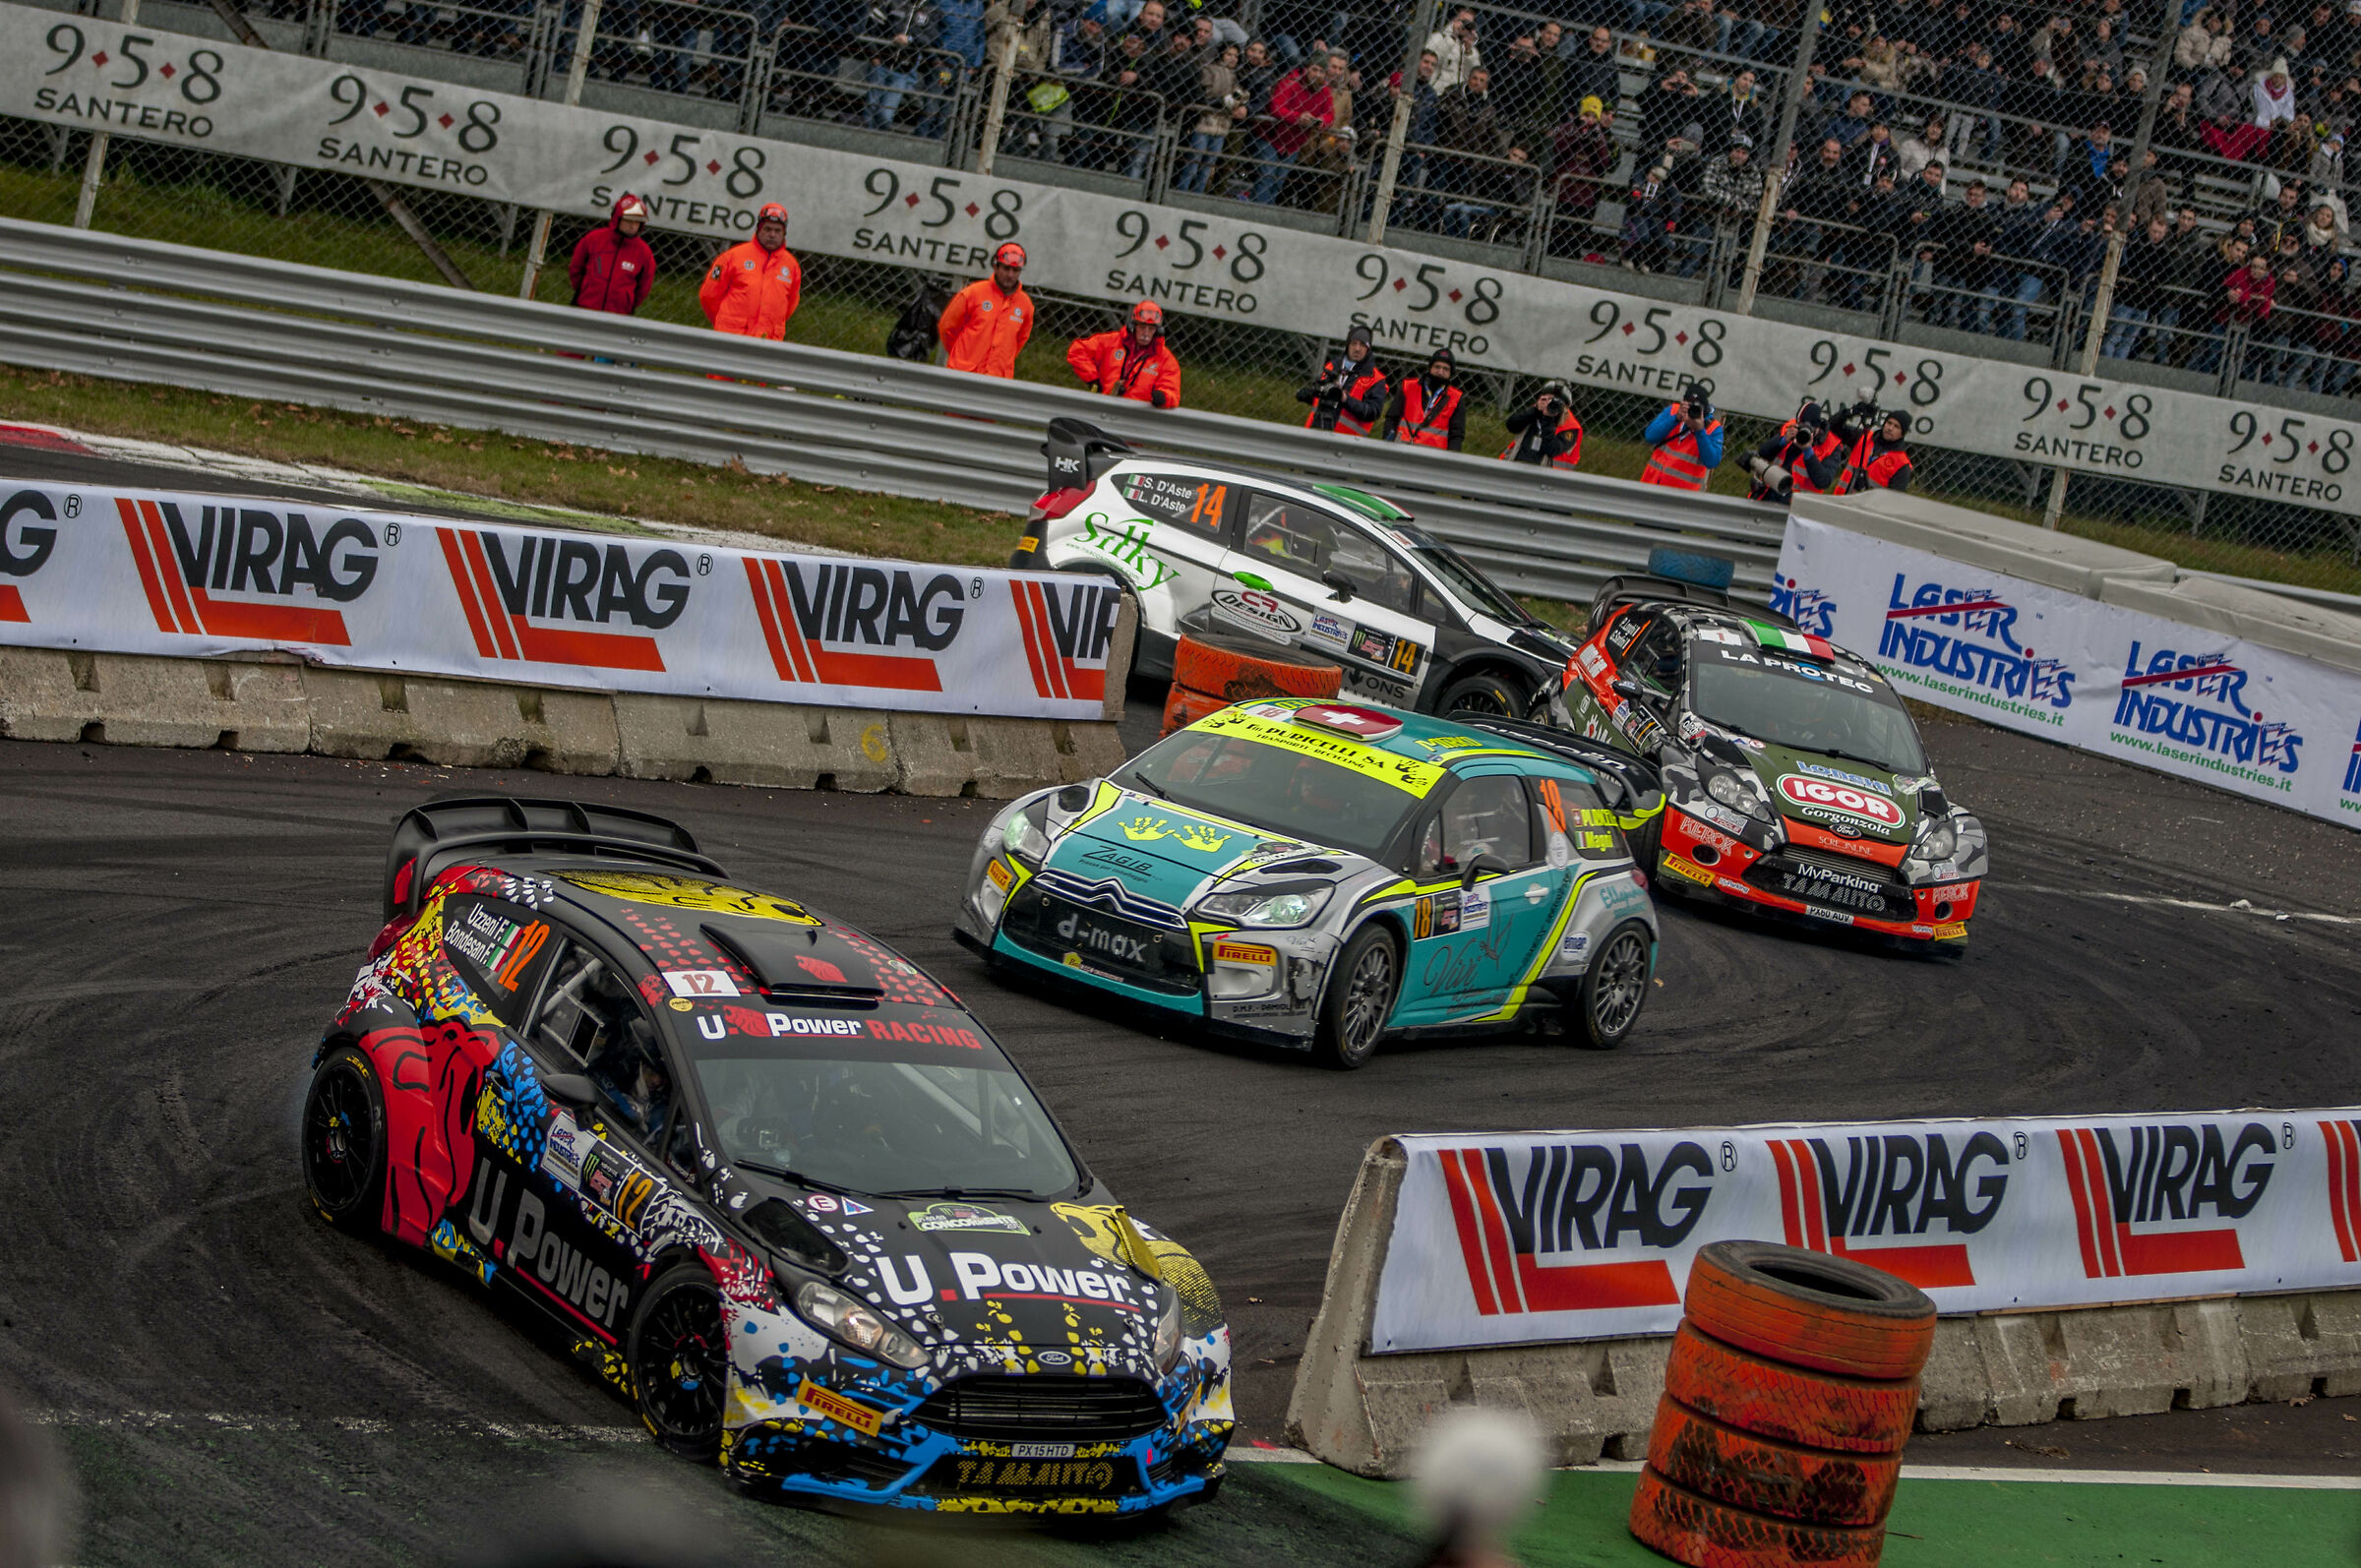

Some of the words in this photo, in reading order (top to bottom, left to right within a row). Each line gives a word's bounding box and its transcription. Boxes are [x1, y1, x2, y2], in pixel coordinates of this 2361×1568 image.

[34, 87, 213, 140] SANTERO
[318, 137, 489, 187] SANTERO
[590, 185, 756, 231] SNTERO
[1106, 270, 1258, 314] SANTERO
[1350, 312, 1489, 356] SANTERO
[2015, 432, 2144, 468] SANTERO
[1138, 492, 1149, 504] L.
[1151, 494, 1186, 513] D'Aste
[1142, 477, 1154, 489] S.
[1157, 480, 1192, 499] D'Aste
[1191, 483, 1227, 527] 14
[2219, 464, 2343, 503] SANTERO
[160, 502, 379, 602] VIRAG
[480, 530, 692, 630] VIRAG
[782, 560, 965, 651] VIRAG
[1220, 593, 1294, 632] DESIGN
[1887, 573, 2023, 654] LASER
[1393, 638, 1418, 674] 14
[1722, 649, 1760, 665] LA
[1764, 657, 1874, 694] PROTEC
[1878, 620, 2076, 708] INDUSTRIES
[1876, 661, 2065, 727] www.laserindustries.it
[2122, 640, 2252, 719] LASER
[1266, 726, 1358, 757] PURICELLI
[1362, 754, 1385, 769] SA
[2112, 687, 2304, 774] INDUSTRIES
[2110, 731, 2293, 792] www.laserindustries.it
[1540, 779, 1566, 833] 18
[1793, 780, 1890, 819] IGOR
[1801, 807, 1891, 837] Gorgonzola
[1836, 823, 1855, 836] Ford
[1668, 857, 1711, 884] PIRELLI
[1798, 864, 1883, 893] MyParking
[444, 921, 487, 959] Bondesan
[467, 902, 501, 936] Uzzeni
[1058, 913, 1147, 962] d-max
[1415, 897, 1432, 939] 18
[498, 920, 550, 992] 12
[1218, 944, 1272, 963] PIRELLI
[681, 973, 722, 995] 12
[765, 1012, 862, 1036] Power
[865, 1019, 983, 1050] RACING
[1806, 1131, 2010, 1237] VIRAG
[2094, 1122, 2276, 1223] VIRAG
[618, 1172, 653, 1230] 12
[1484, 1141, 1715, 1254] VIRAG
[1044, 1353, 1067, 1364] Ford
[805, 1386, 874, 1429] PIRELLI
